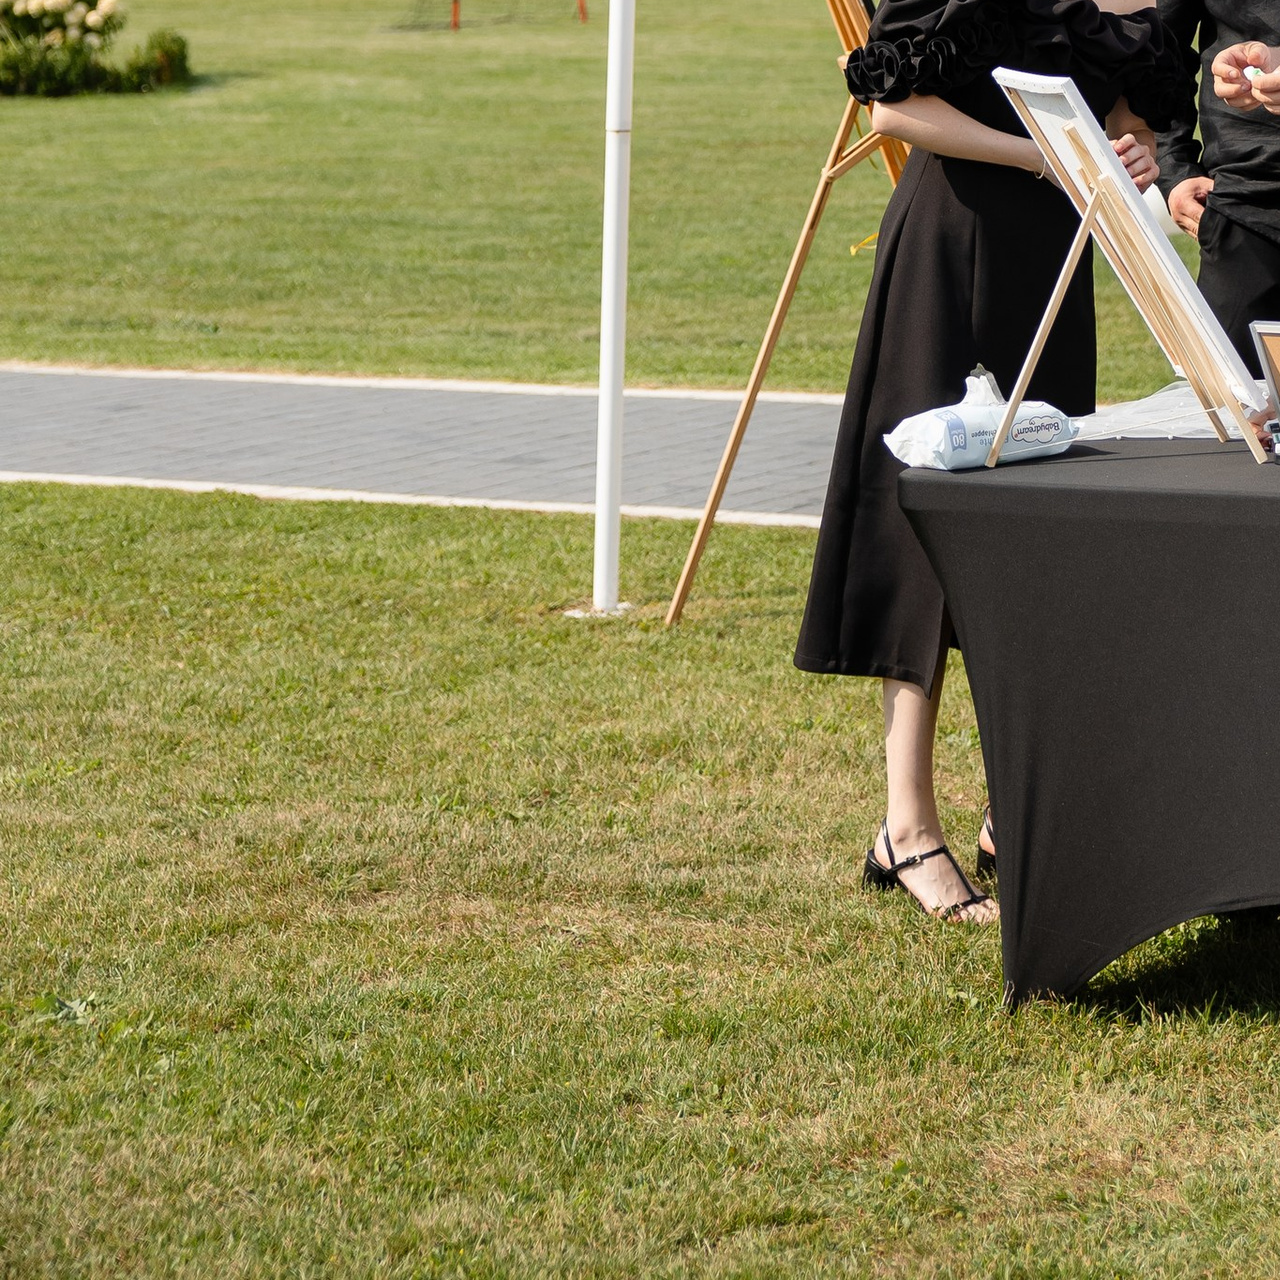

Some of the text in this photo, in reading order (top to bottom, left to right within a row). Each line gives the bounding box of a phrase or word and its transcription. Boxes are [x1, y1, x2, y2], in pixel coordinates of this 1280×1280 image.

[971, 429, 998, 438] chlappen
[1016, 421, 1060, 435] Babydream
[952, 433, 965, 447] 80
